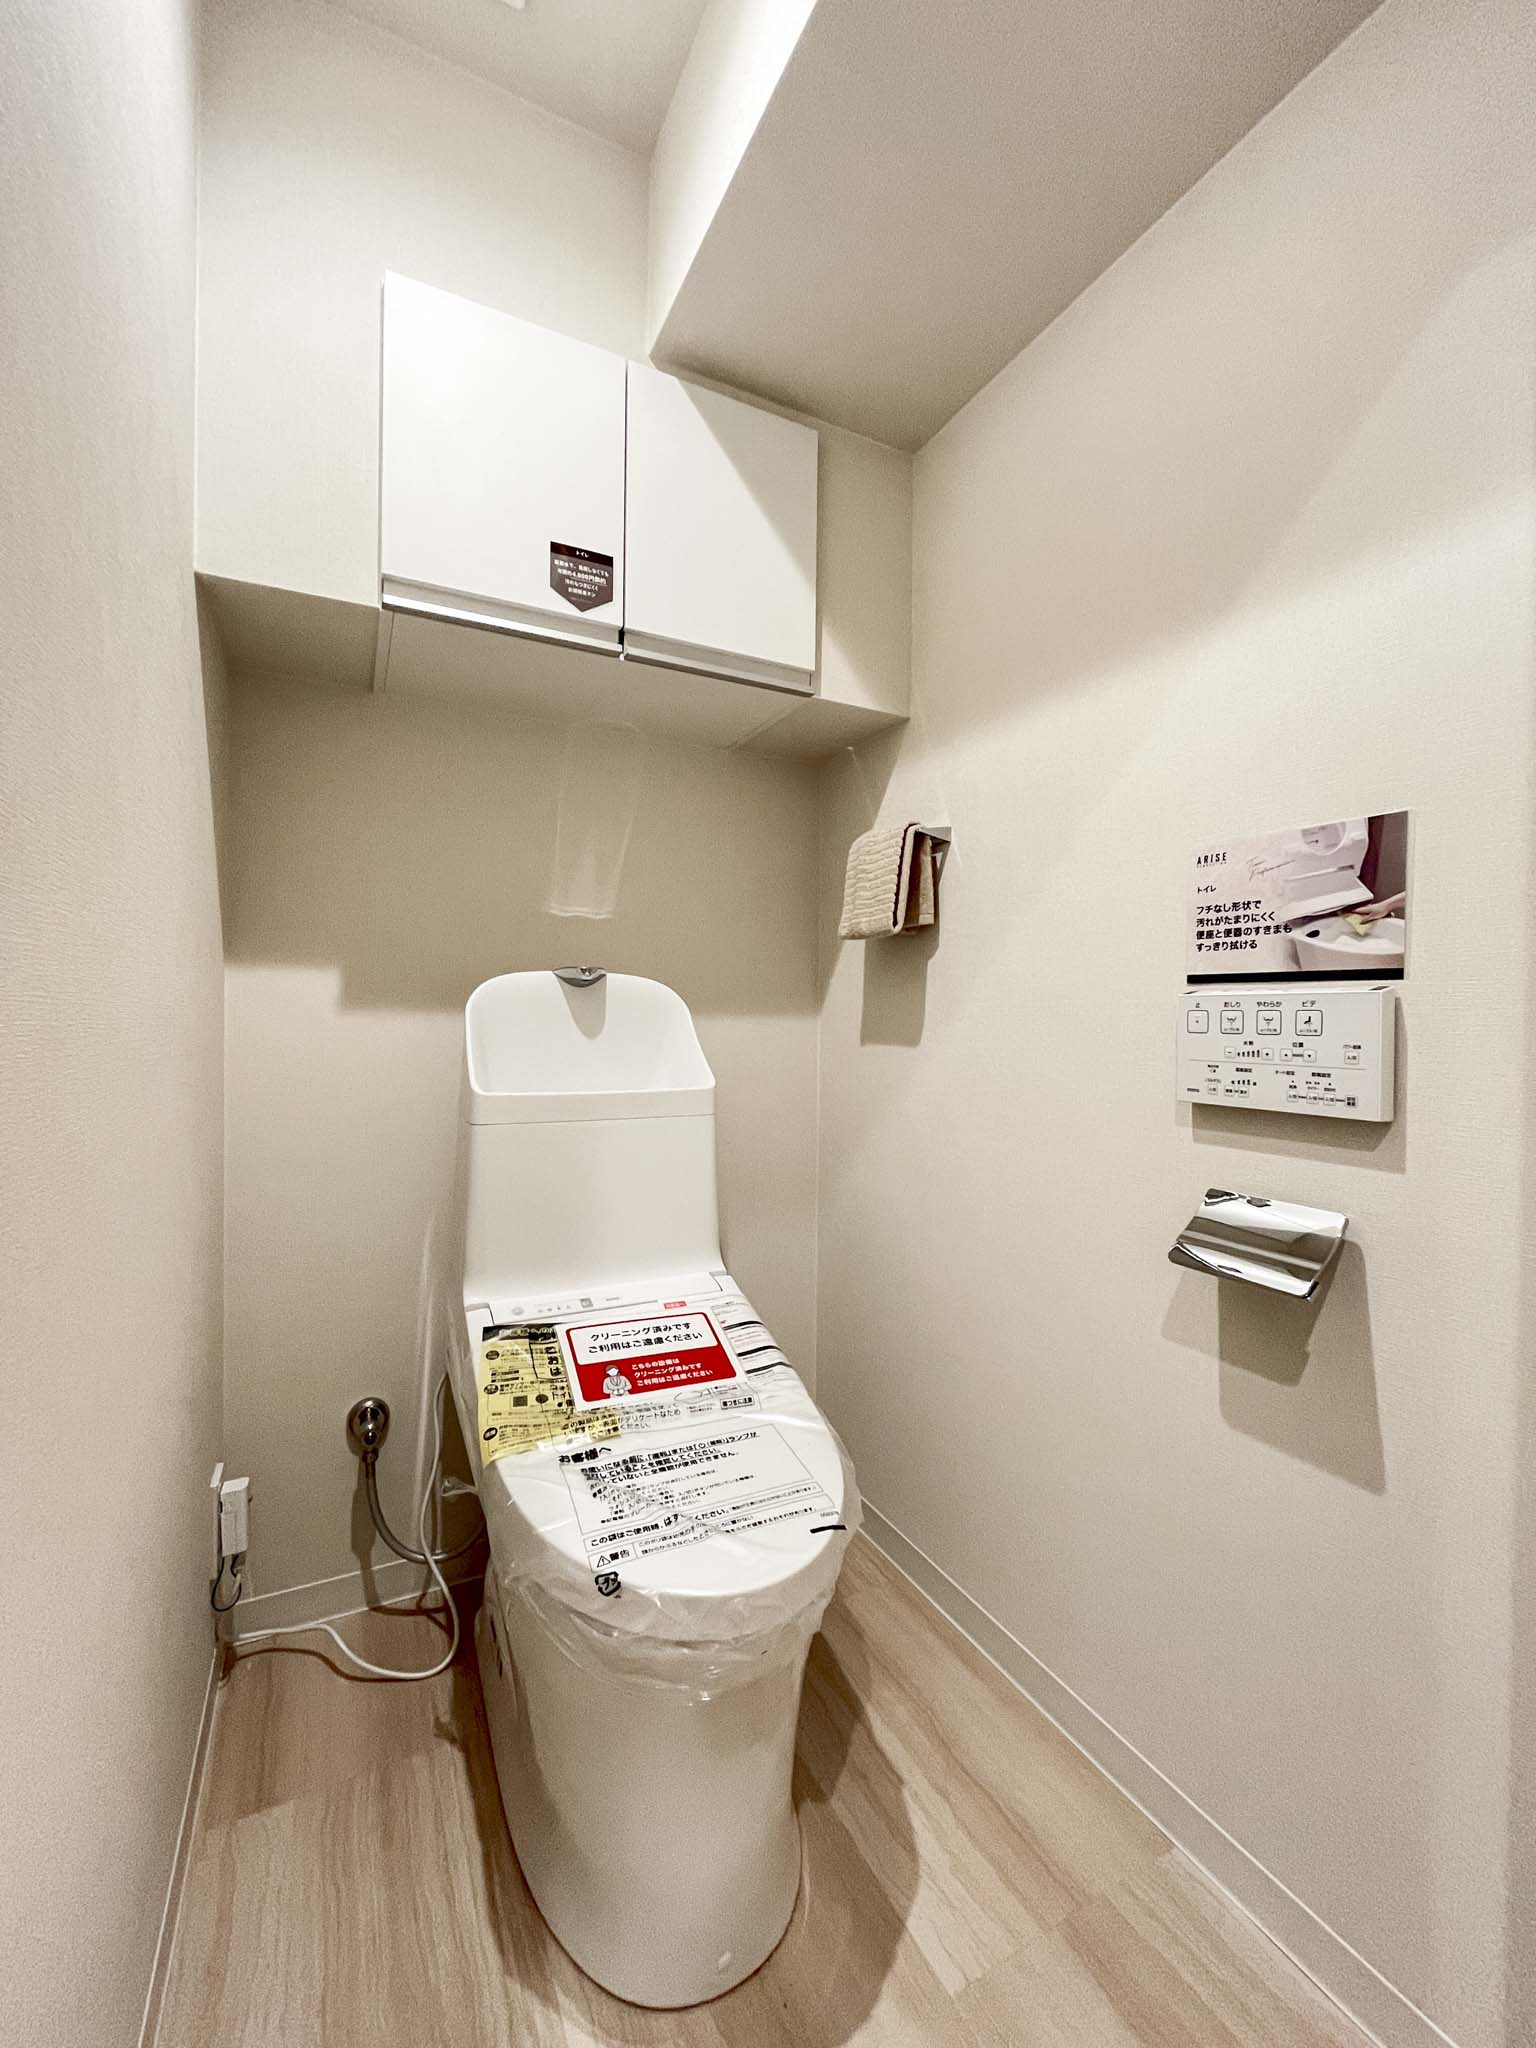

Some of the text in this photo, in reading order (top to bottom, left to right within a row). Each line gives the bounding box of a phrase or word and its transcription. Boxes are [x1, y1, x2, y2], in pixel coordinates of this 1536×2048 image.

[1197, 851, 1228, 865] ARISE
[1197, 885, 1217, 895] トイレ
[1196, 900, 1262, 915] フチなし形状で
[1196, 911, 1275, 928] 汚れがたまりにくく
[1196, 923, 1293, 940] 便座と便器のすきまも
[1196, 939, 1258, 953] すっきり拭ける
[1301, 1000, 1317, 1008] ビデ
[590, 1321, 692, 1342] クリーニング済みです
[588, 1331, 703, 1354] ご利用はご遠慮ください
[631, 1358, 680, 1370] こちらの設備は
[634, 1362, 702, 1379] クリーニング済みです
[636, 1369, 714, 1387] ご利用はご遠慮ください
[559, 1447, 612, 1463] お客様へ
[609, 1549, 630, 1562] 警告
